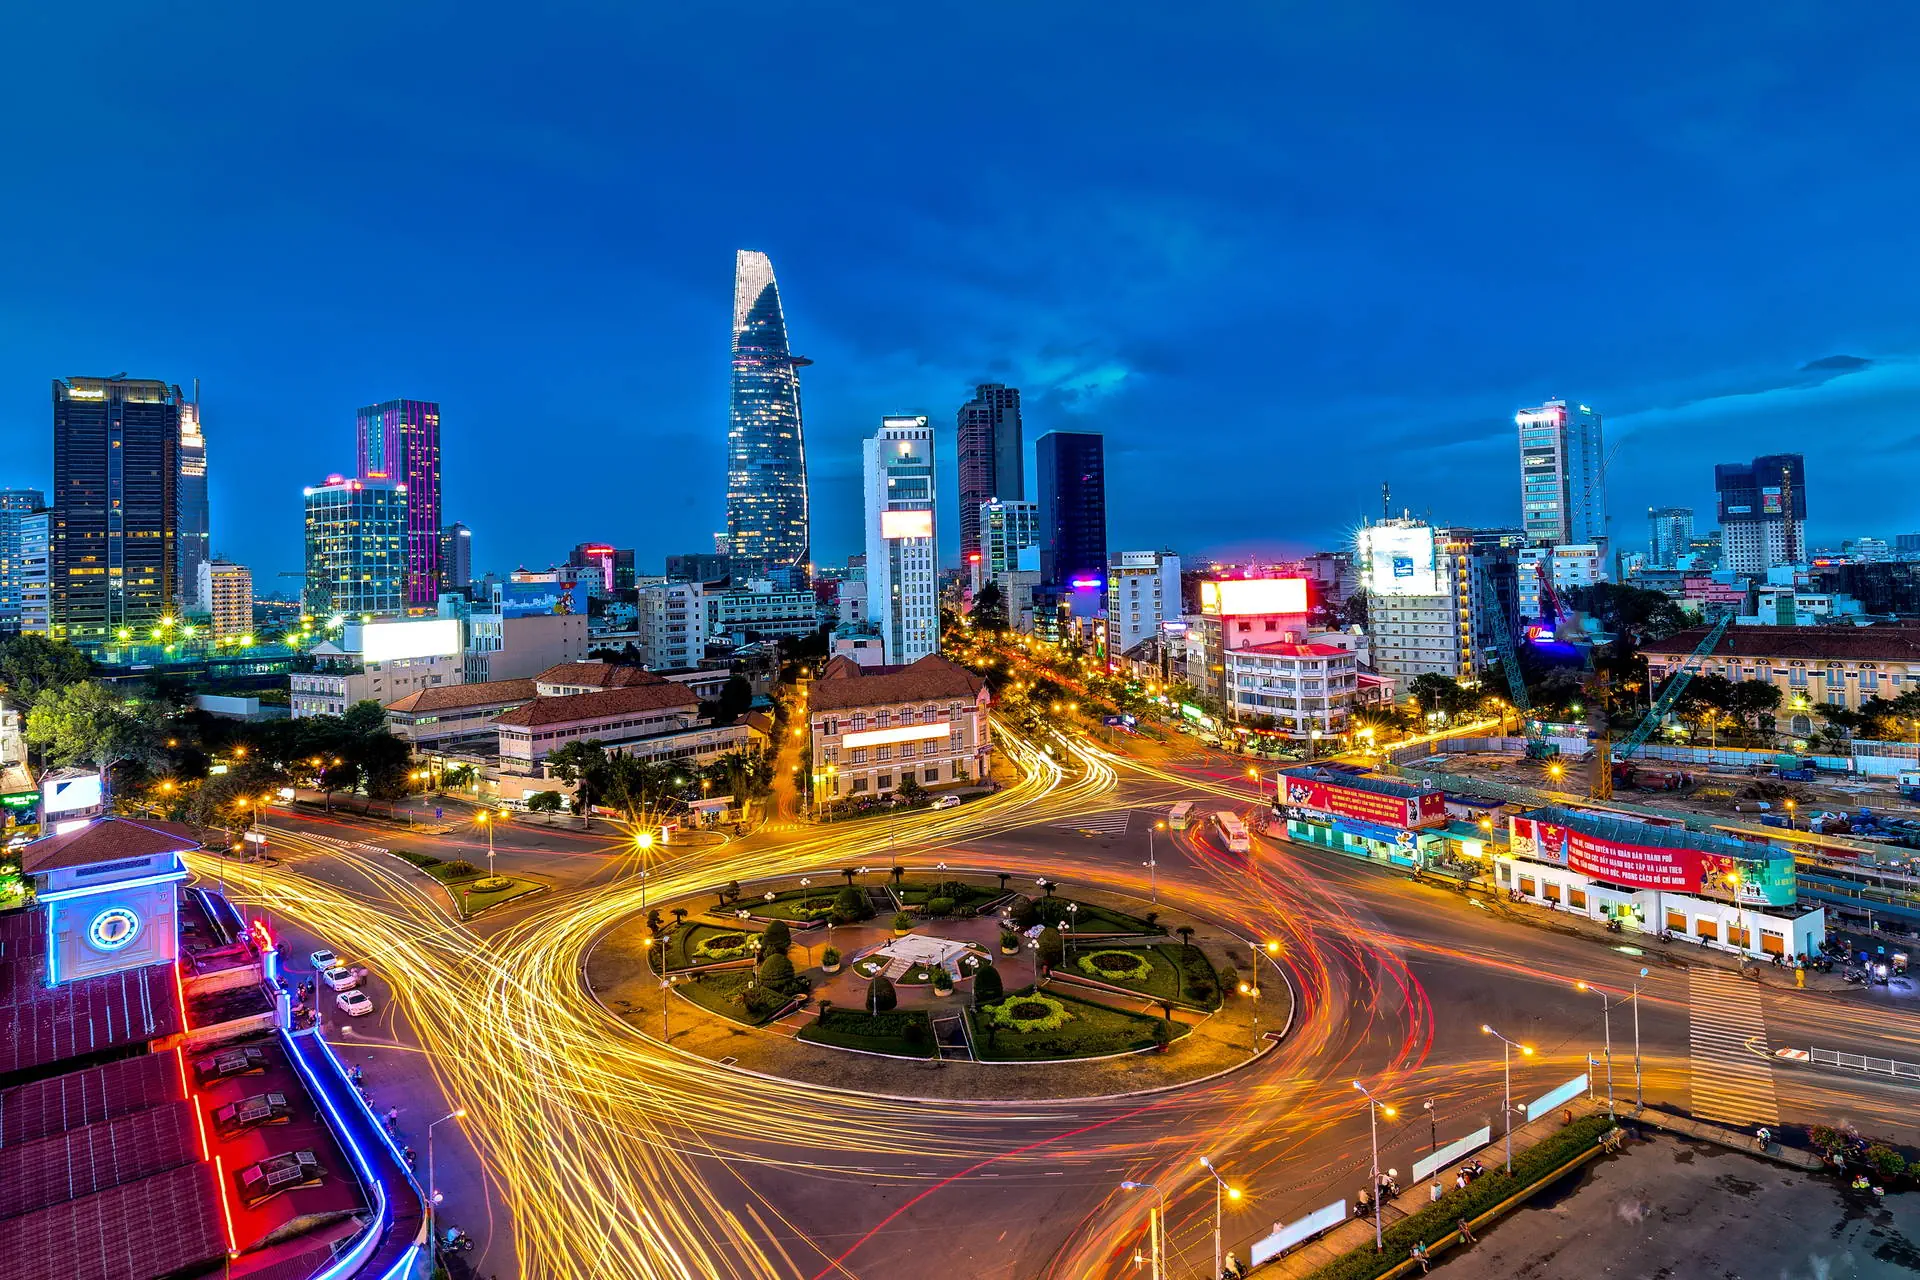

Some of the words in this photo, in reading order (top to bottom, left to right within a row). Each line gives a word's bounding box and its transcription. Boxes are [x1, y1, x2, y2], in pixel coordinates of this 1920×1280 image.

[1609, 847, 1617, 856] VÀ
[1643, 853, 1661, 862] THÀNH
[1646, 864, 1655, 872] VÀ
[1669, 866, 1683, 875] THEO
